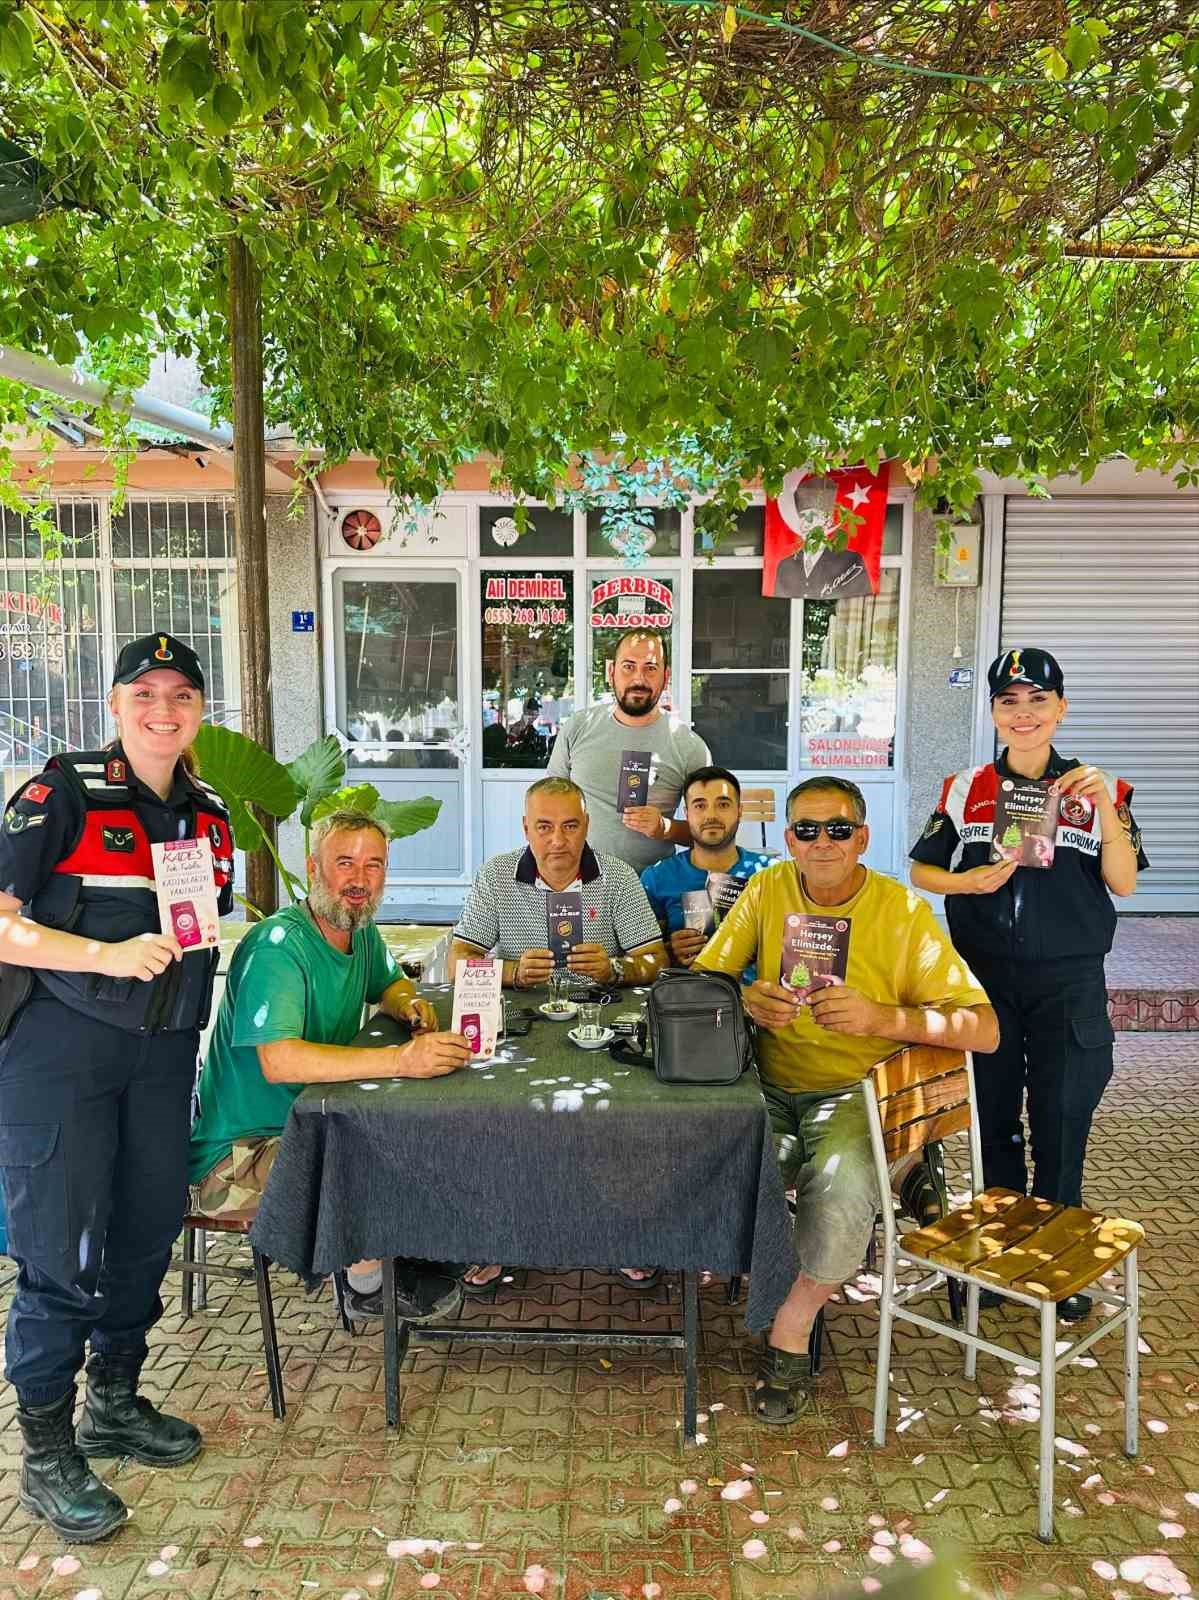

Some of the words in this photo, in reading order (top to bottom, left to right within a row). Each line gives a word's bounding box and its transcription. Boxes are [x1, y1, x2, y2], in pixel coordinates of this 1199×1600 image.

[486, 578, 505, 599] Ali
[507, 573, 567, 600] DEMİREL
[591, 576, 673, 611] BERBER
[485, 607, 512, 624] 0553
[514, 608, 534, 624] 268
[537, 607, 550, 624] 14
[551, 608, 566, 624] 84
[590, 613, 672, 628] SALONU
[1013, 793, 1046, 804] Herşey
[1062, 831, 1100, 851] KORUMA
[162, 849, 204, 864] KADES
[800, 929, 834, 942] Herşey
